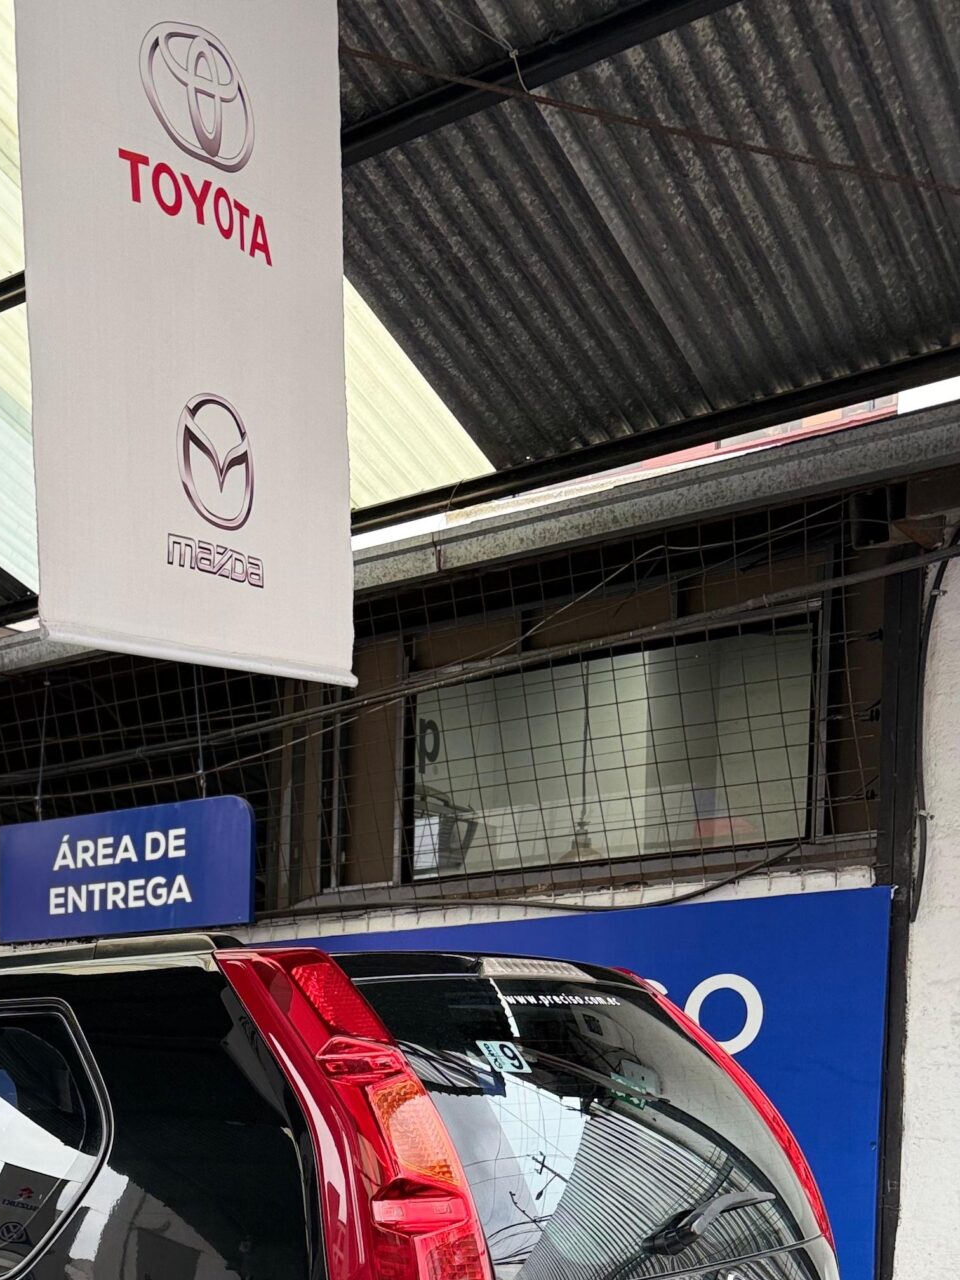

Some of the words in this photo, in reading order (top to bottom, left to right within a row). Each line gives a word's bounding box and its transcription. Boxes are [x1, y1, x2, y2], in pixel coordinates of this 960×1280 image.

[118, 147, 273, 267] TOYOTA
[53, 834, 137, 872] ÁREA
[144, 828, 187, 861] DE
[49, 875, 192, 916] ENTREGA
